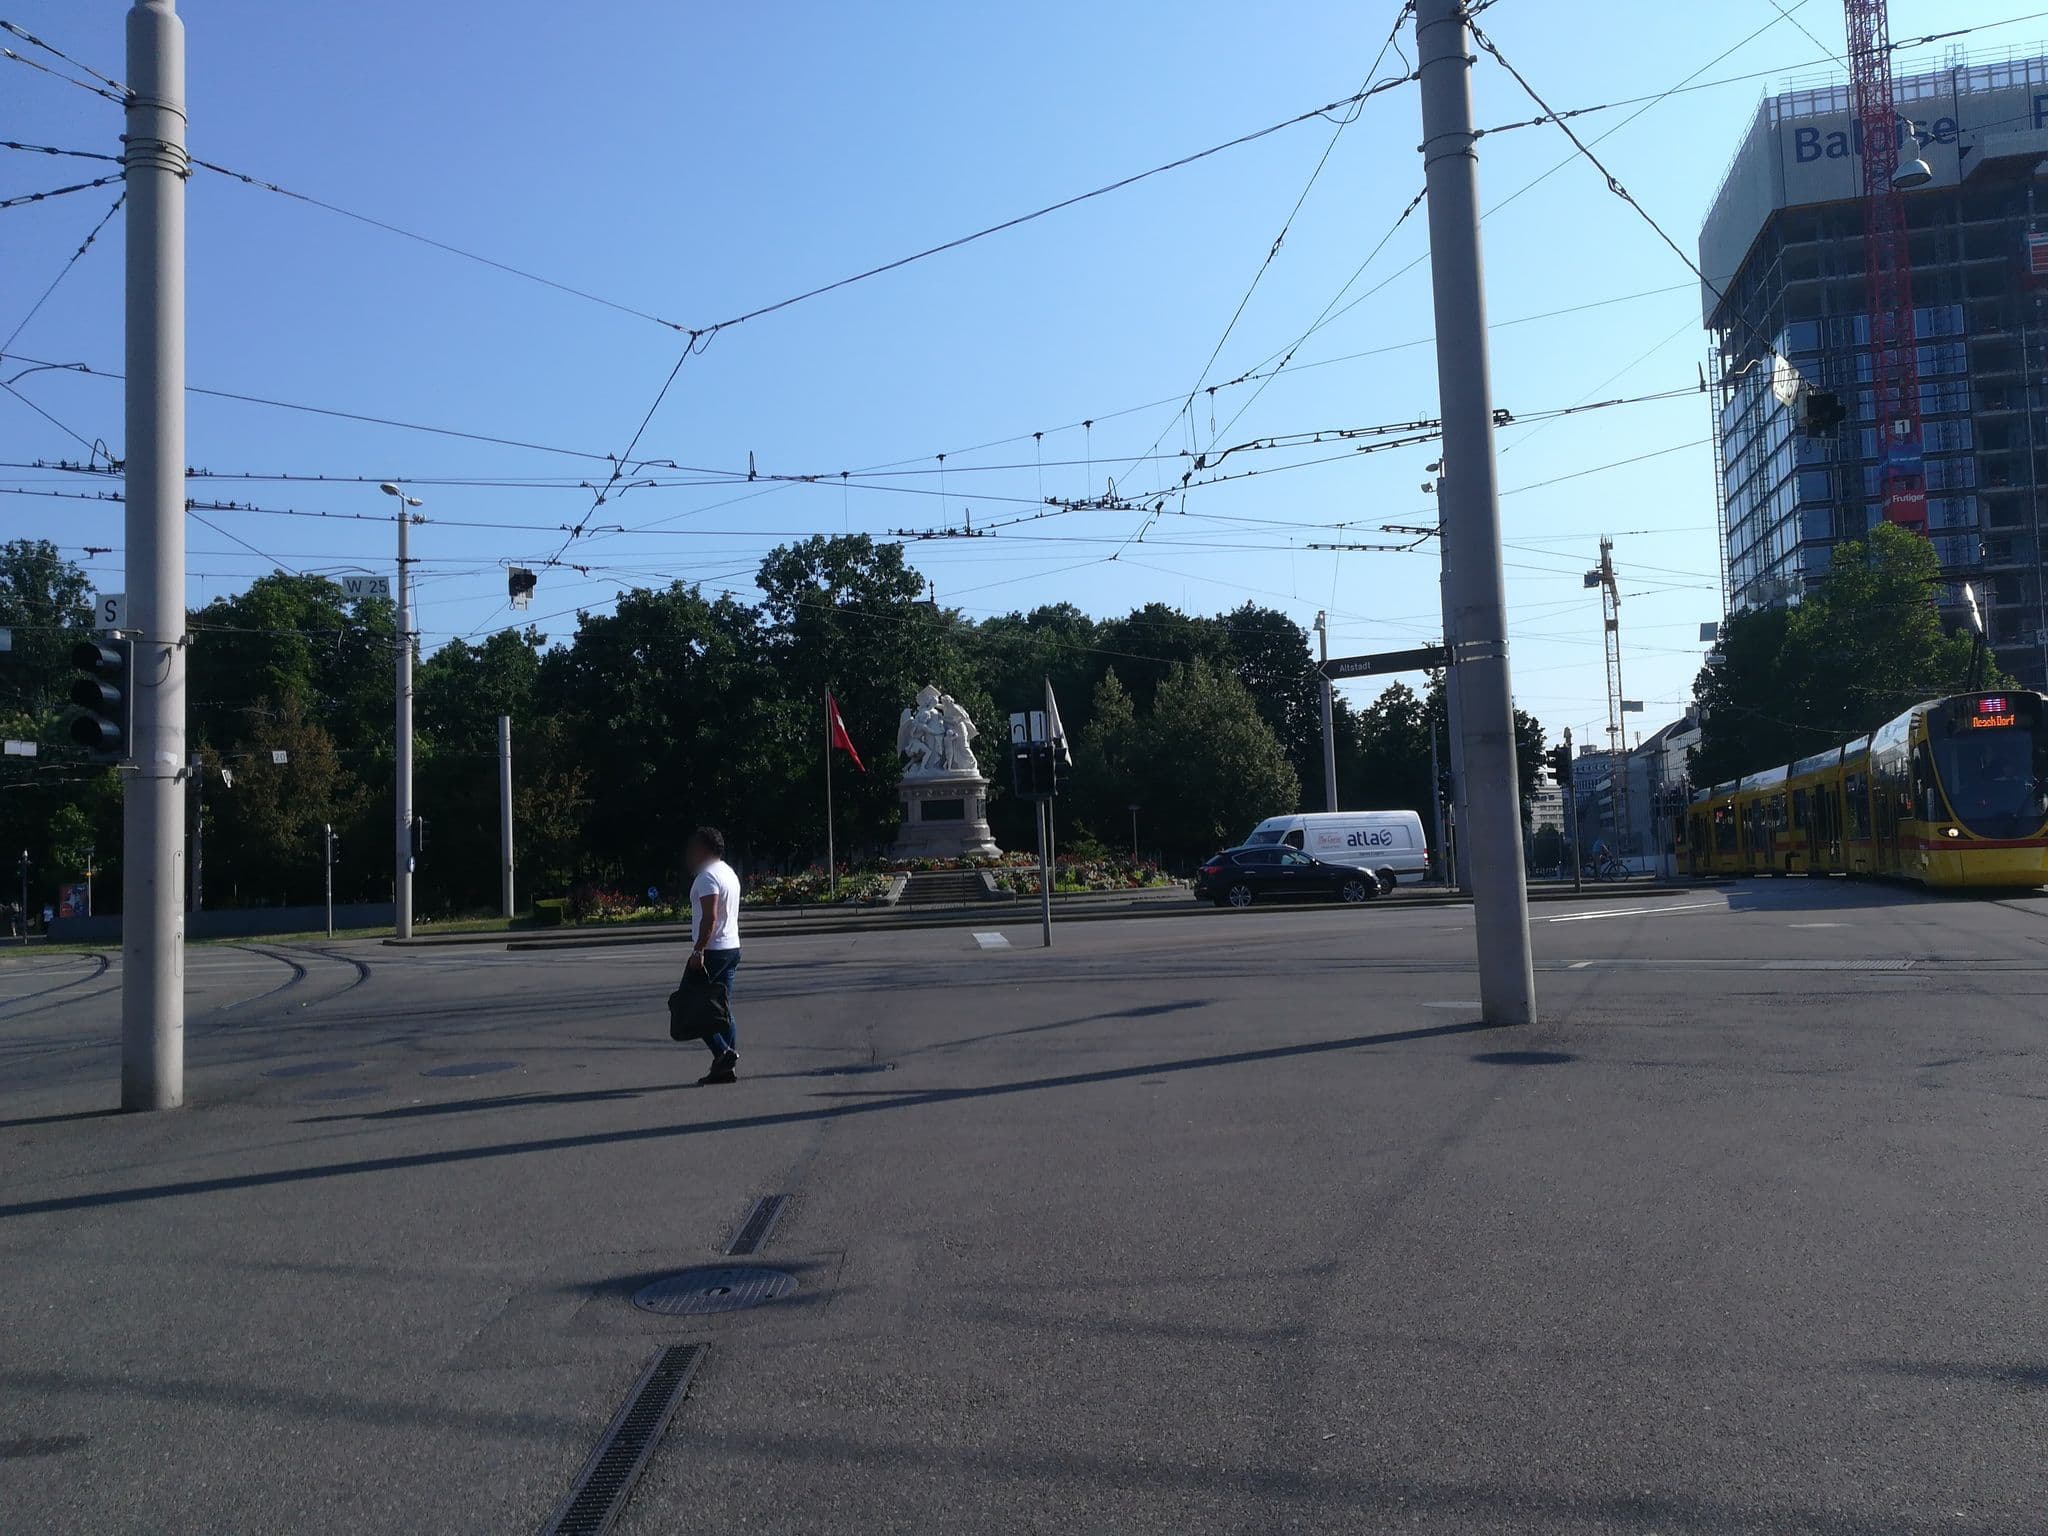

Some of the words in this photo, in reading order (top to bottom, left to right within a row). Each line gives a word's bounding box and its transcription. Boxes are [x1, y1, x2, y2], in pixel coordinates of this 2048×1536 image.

[1892, 493, 1924, 503] Frutiger
[347, 579, 363, 594] W
[369, 580, 387, 593] 25
[104, 600, 116, 622] S
[1339, 661, 1371, 673] Altstadt
[1996, 714, 2015, 726] Dorf
